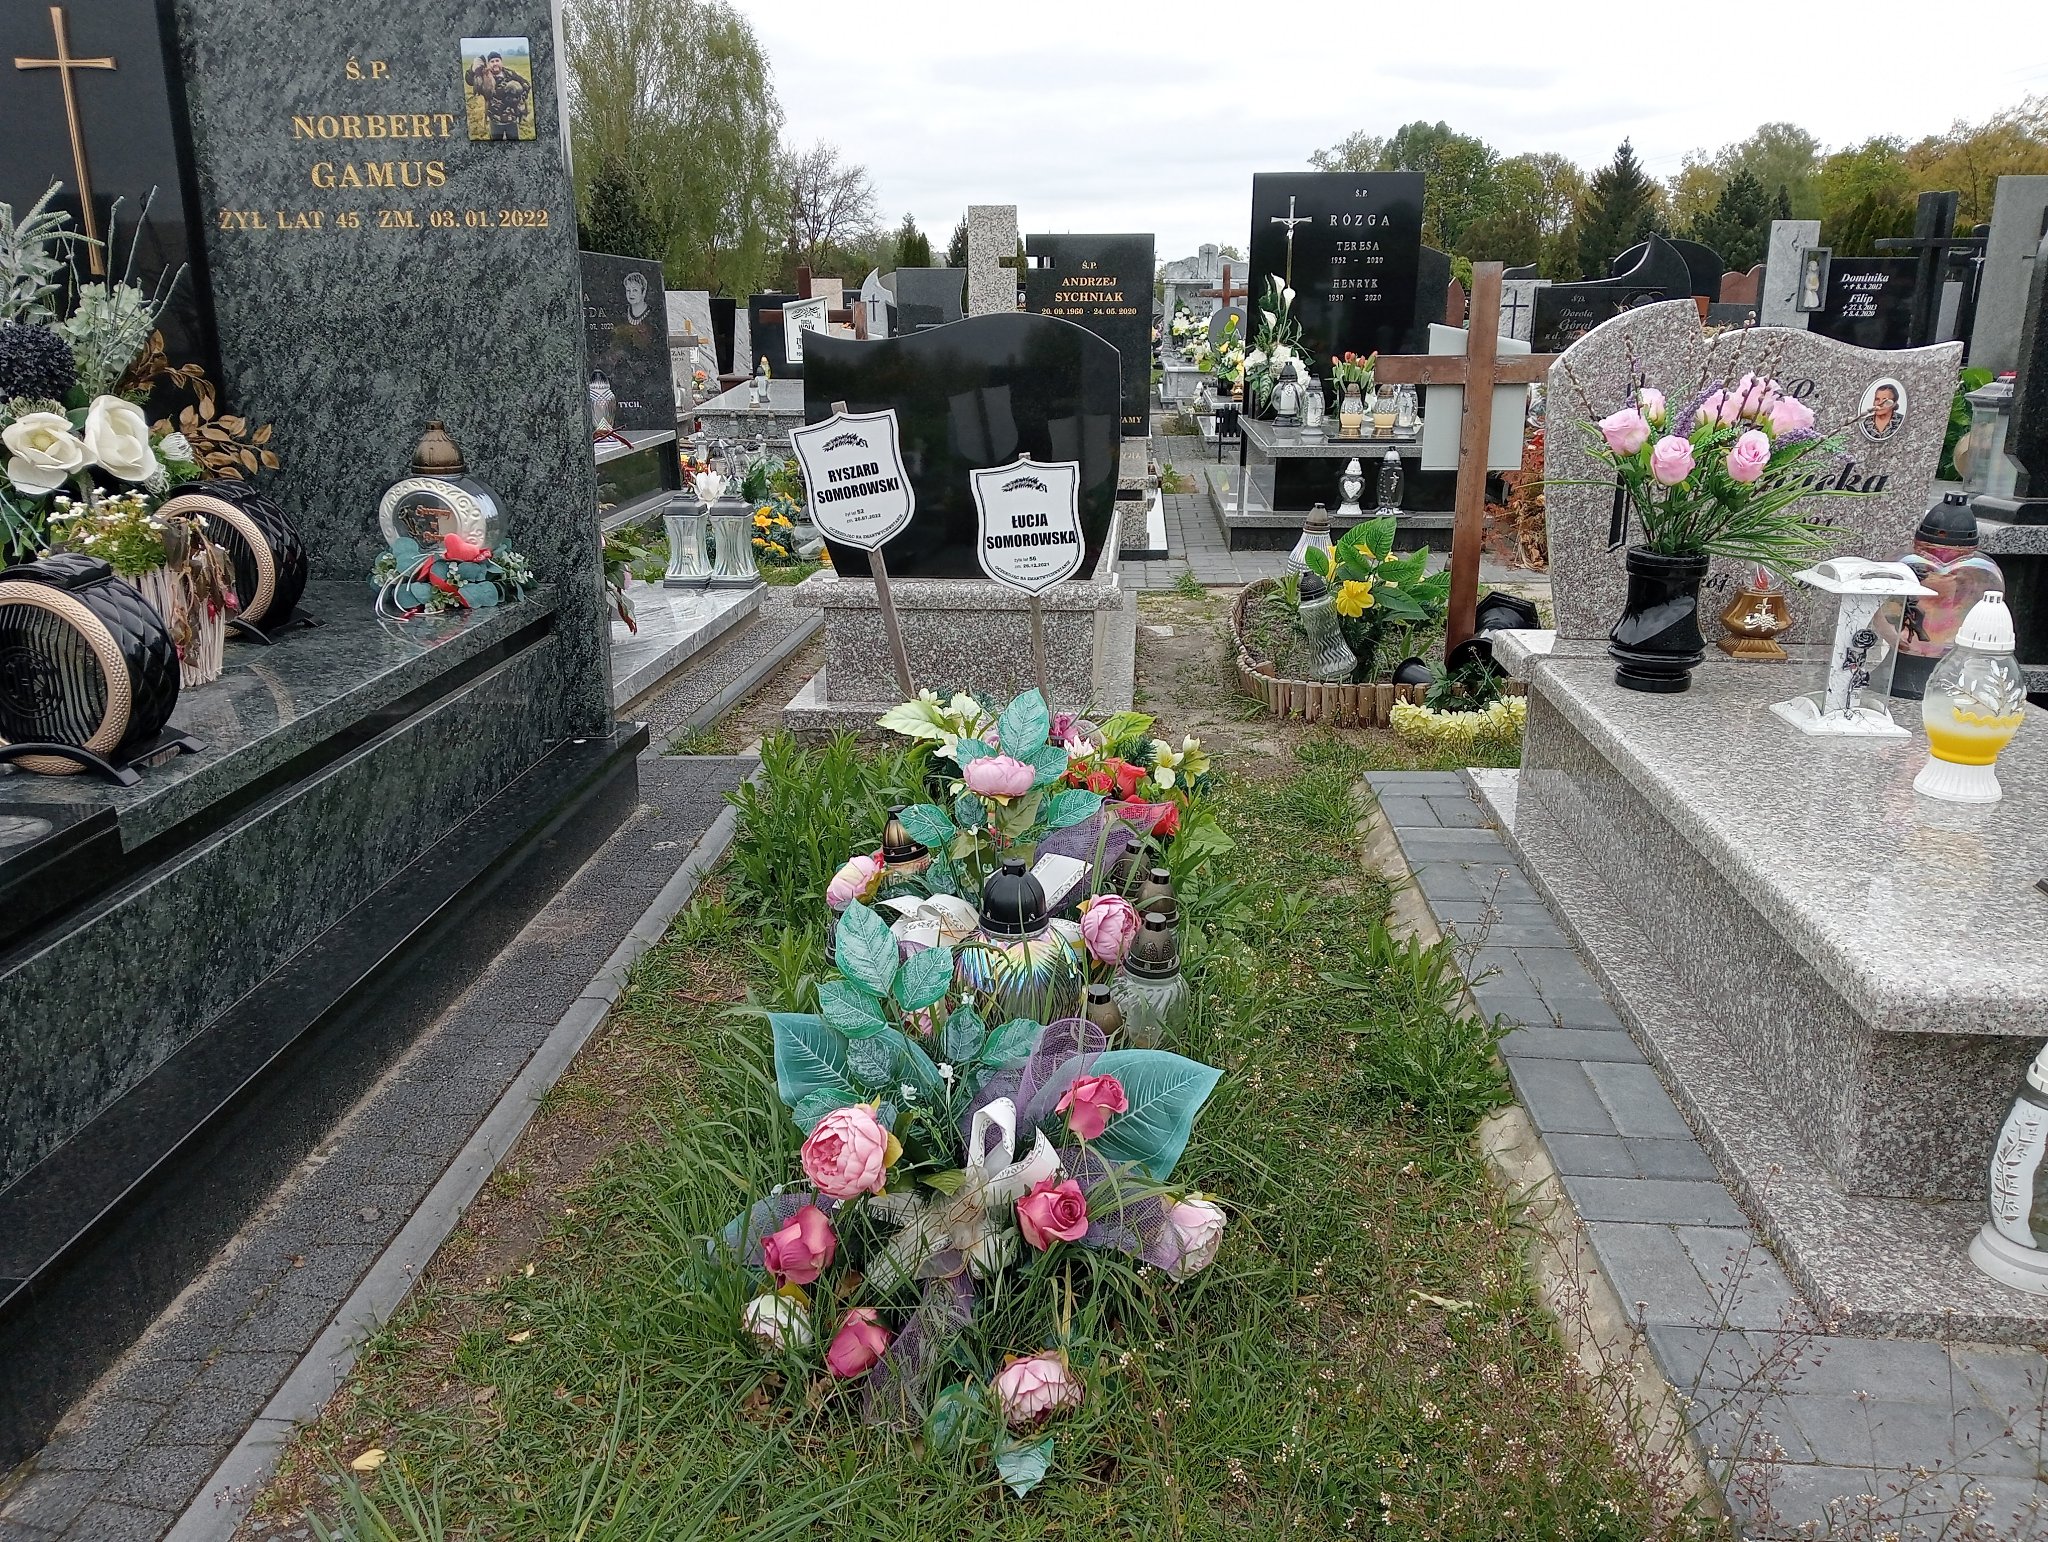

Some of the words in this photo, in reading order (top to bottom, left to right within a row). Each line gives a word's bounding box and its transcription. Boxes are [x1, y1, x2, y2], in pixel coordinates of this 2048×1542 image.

[291, 114, 454, 139] NORBERT
[311, 161, 446, 188] GAMUS
[219, 208, 267, 230] ŻYŁ
[277, 210, 324, 229] LAT
[336, 211, 360, 228] 45
[378, 210, 420, 228] ZM.
[1336, 241, 1380, 251] TERESA
[1330, 256, 1347, 264] 1952
[1062, 277, 1117, 287] ANDRZEJ
[1332, 279, 1378, 289] HENRYK
[1840, 272, 1890, 283] Dominika
[1054, 292, 1124, 302] SYCHNIAK
[1849, 293, 1874, 306] Filip
[828, 462, 879, 482] RYSZARD
[816, 477, 900, 504] SOMOROWSKI
[1011, 513, 1048, 528] ŁUCJA
[986, 530, 1077, 549] SOMOROWSKA
